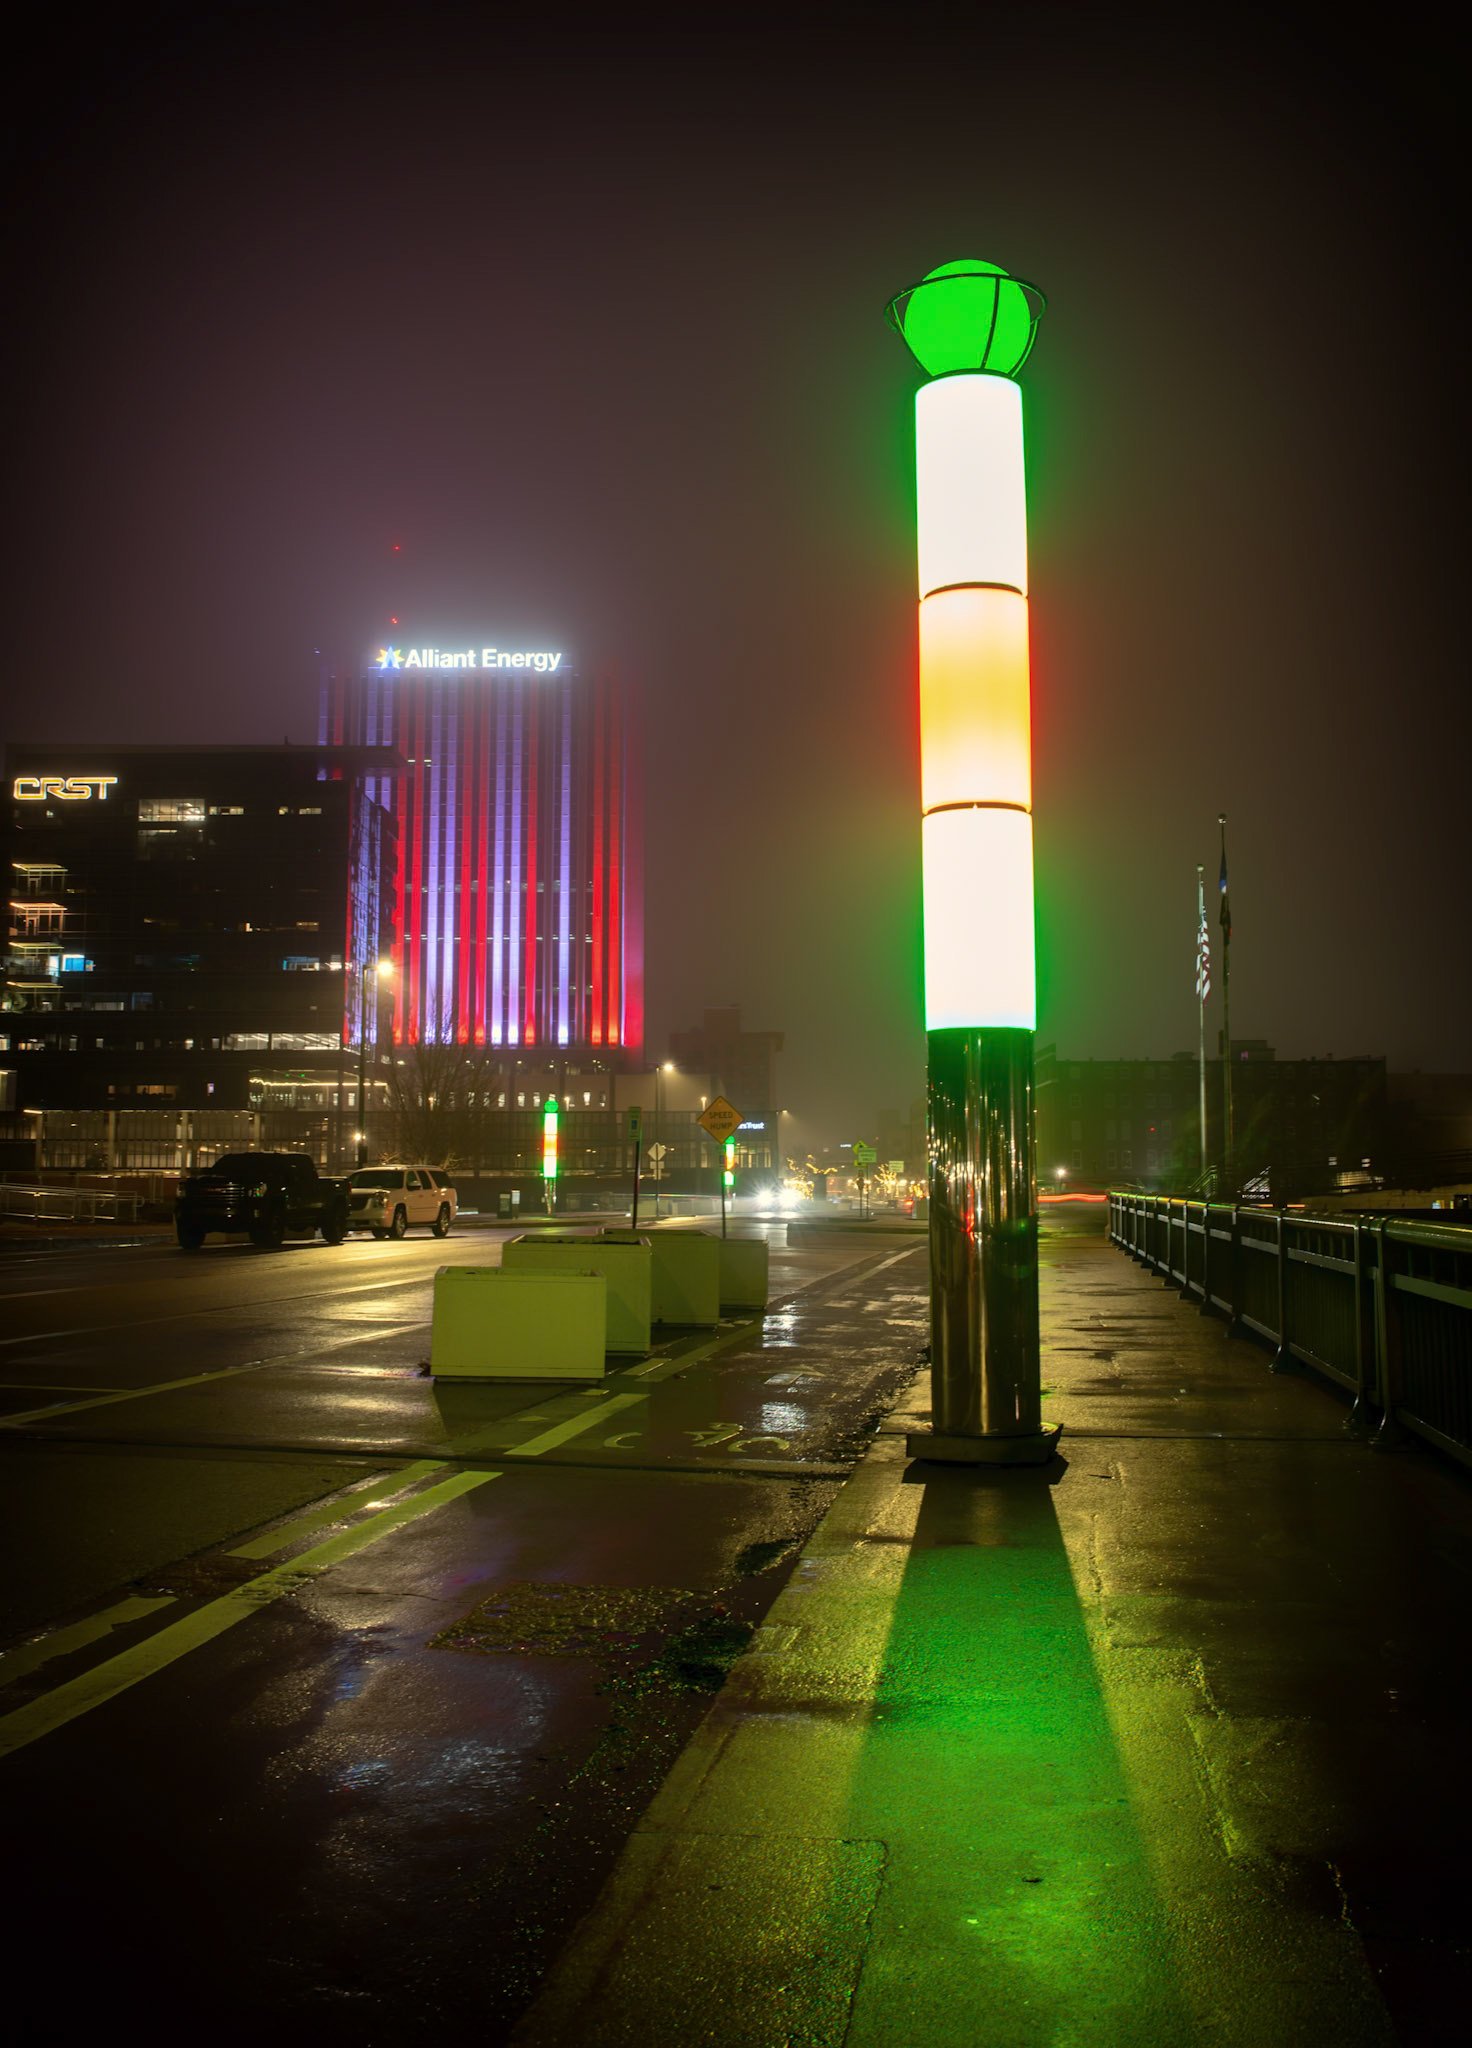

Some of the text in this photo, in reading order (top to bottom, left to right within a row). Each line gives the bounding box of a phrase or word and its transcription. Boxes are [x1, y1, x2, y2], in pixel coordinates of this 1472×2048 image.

[404, 648, 562, 672] Alliant Energy
[13, 777, 118, 800] CRST
[709, 1111, 734, 1119] SPEED
[710, 1122, 733, 1130] HUMP
